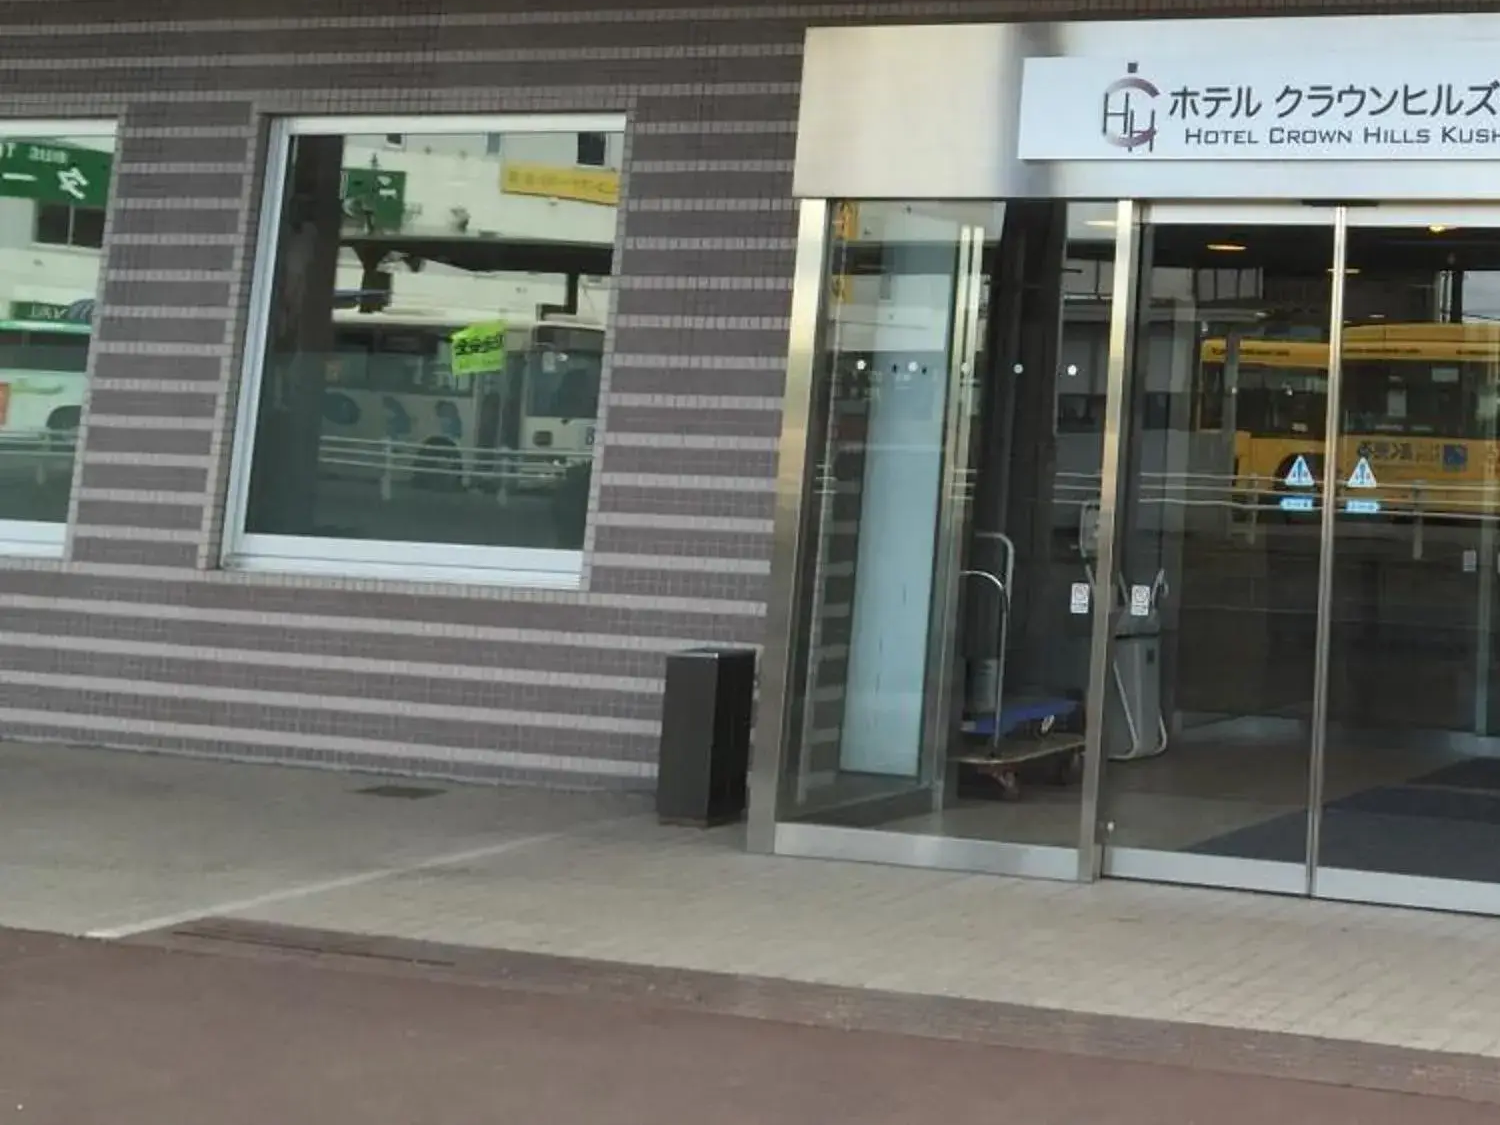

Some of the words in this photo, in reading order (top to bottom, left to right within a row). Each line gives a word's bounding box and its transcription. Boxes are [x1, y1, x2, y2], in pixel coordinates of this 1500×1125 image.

[1168, 85, 1262, 120] ホテル
[1185, 127, 1259, 145] HOTEL
[1268, 127, 1352, 145] CROWN
[1363, 126, 1431, 145] HILLS
